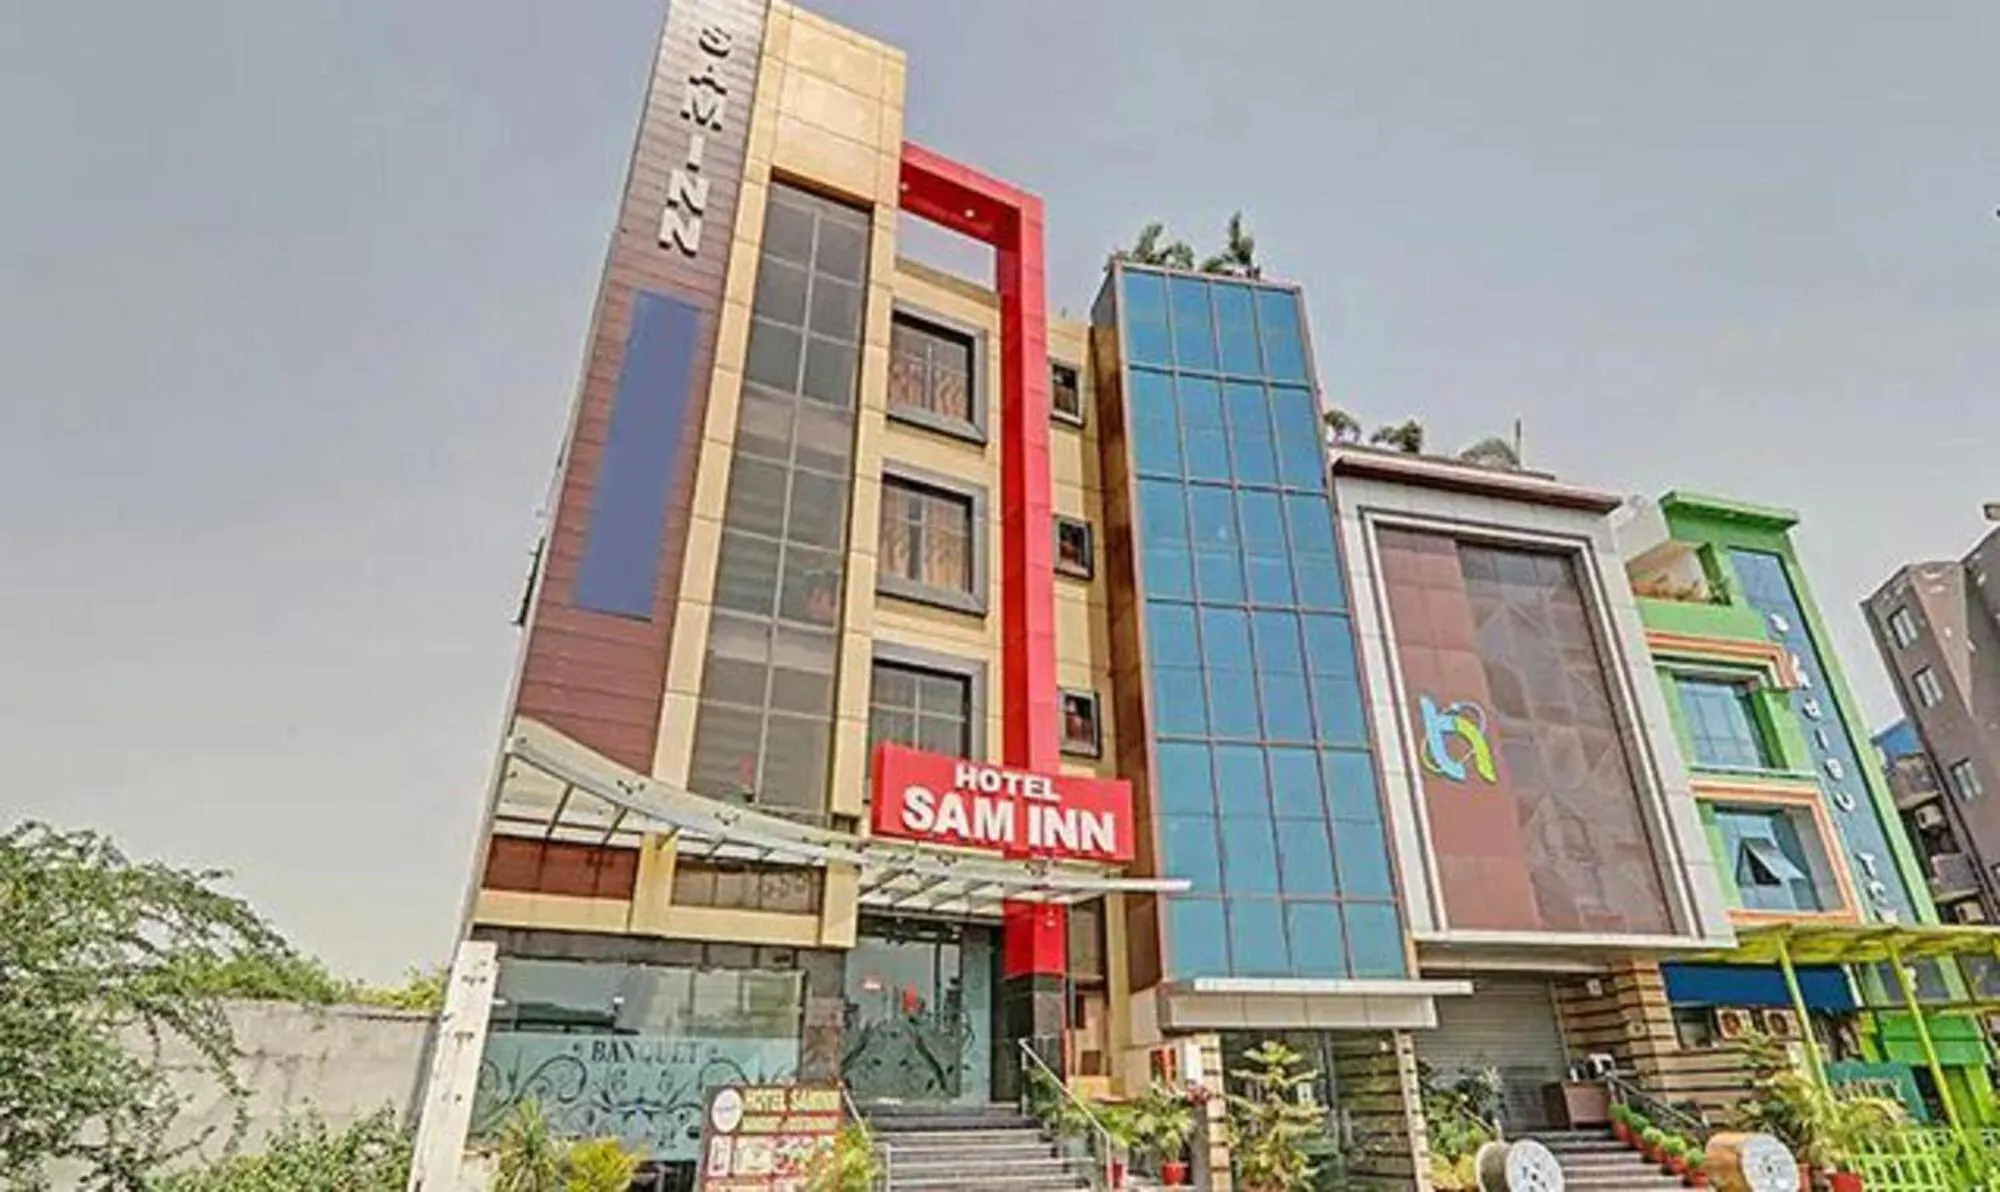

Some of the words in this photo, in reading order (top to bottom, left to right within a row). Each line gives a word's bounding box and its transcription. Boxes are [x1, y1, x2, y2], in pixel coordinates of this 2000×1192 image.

[680, 25, 732, 132] SAM
[658, 133, 709, 258] INN
[955, 762, 1062, 801] HOTEL
[901, 785, 1015, 843] SAM
[1027, 804, 1117, 853] INN
[591, 1038, 701, 1064] BANQUET
